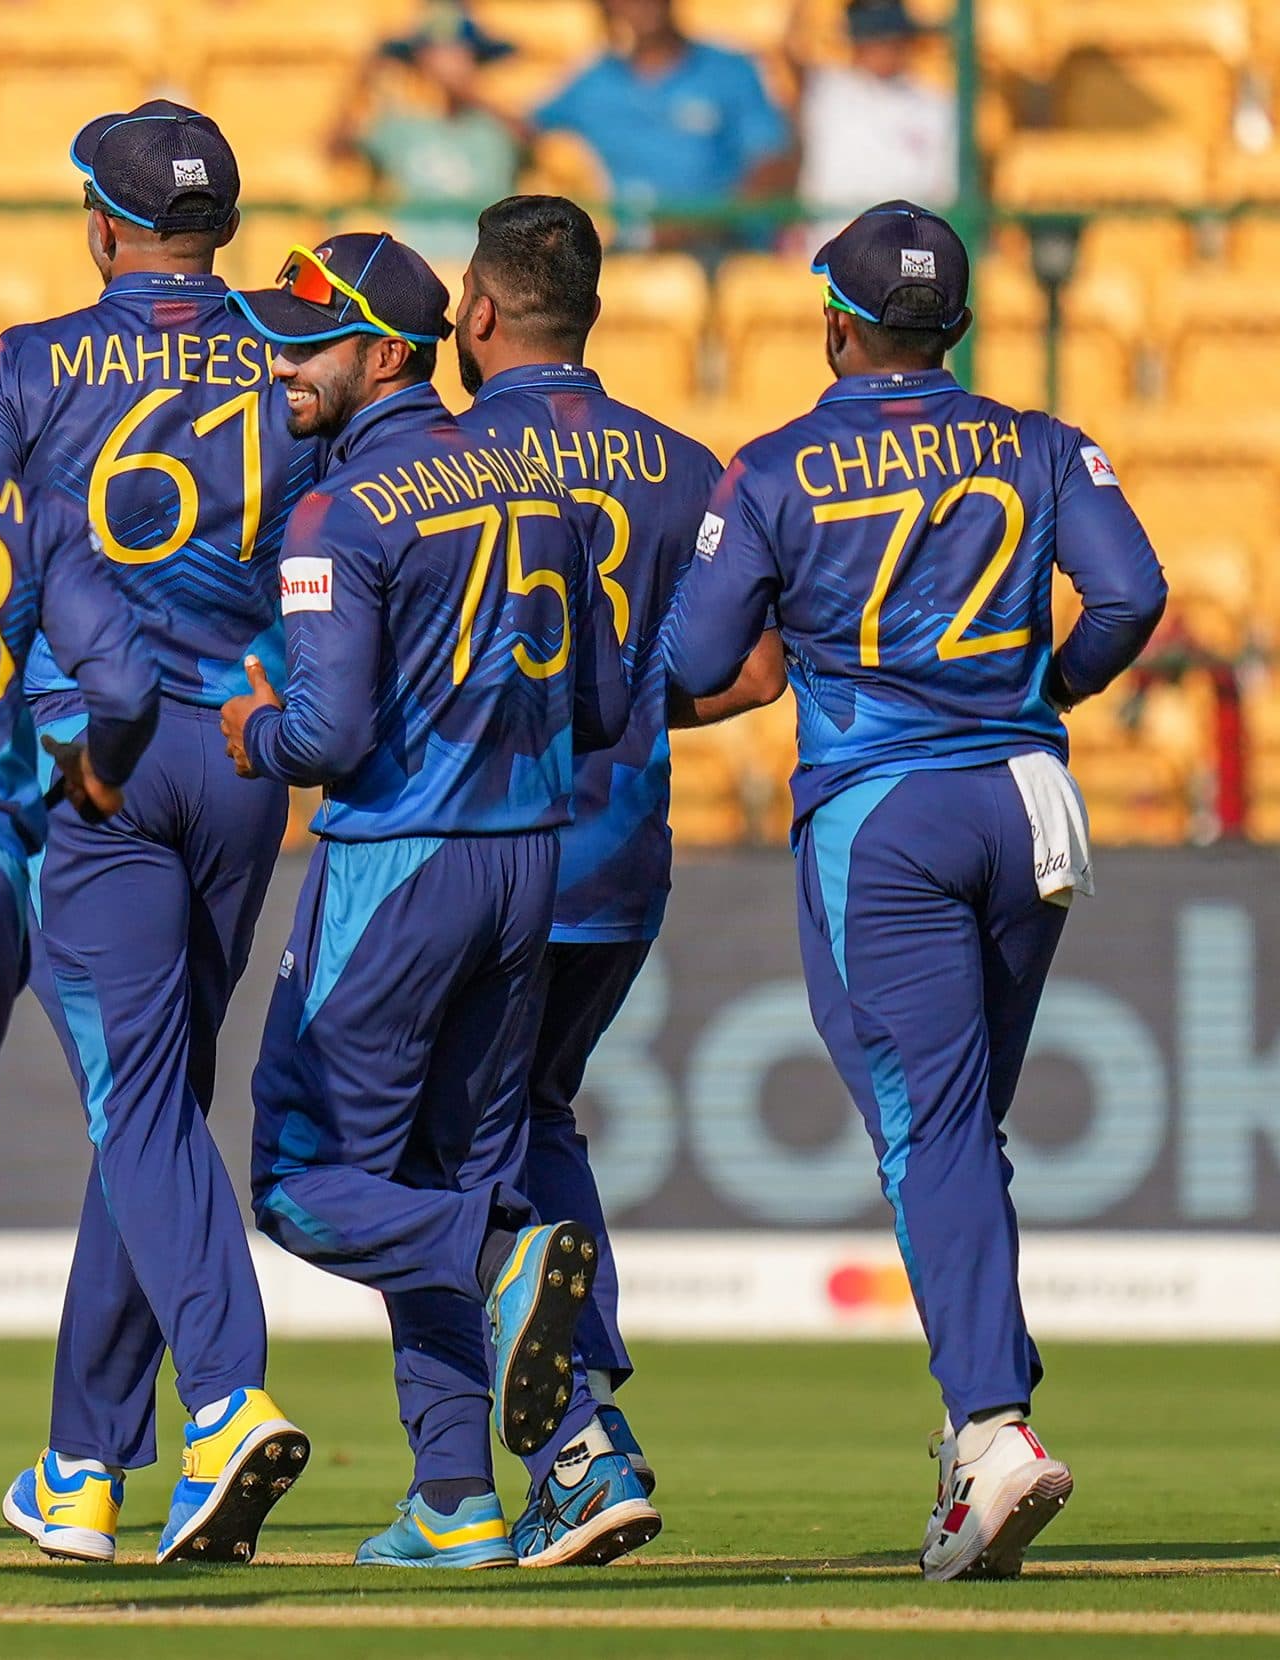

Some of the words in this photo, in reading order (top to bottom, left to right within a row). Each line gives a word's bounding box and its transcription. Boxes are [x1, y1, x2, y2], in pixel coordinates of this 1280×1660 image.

[88, 388, 262, 564] 61
[486, 427, 667, 483] AHIRU
[795, 419, 1022, 497] CHARITH
[279, 574, 328, 597] Amul
[415, 500, 571, 686] 75
[813, 476, 1031, 667] 72
